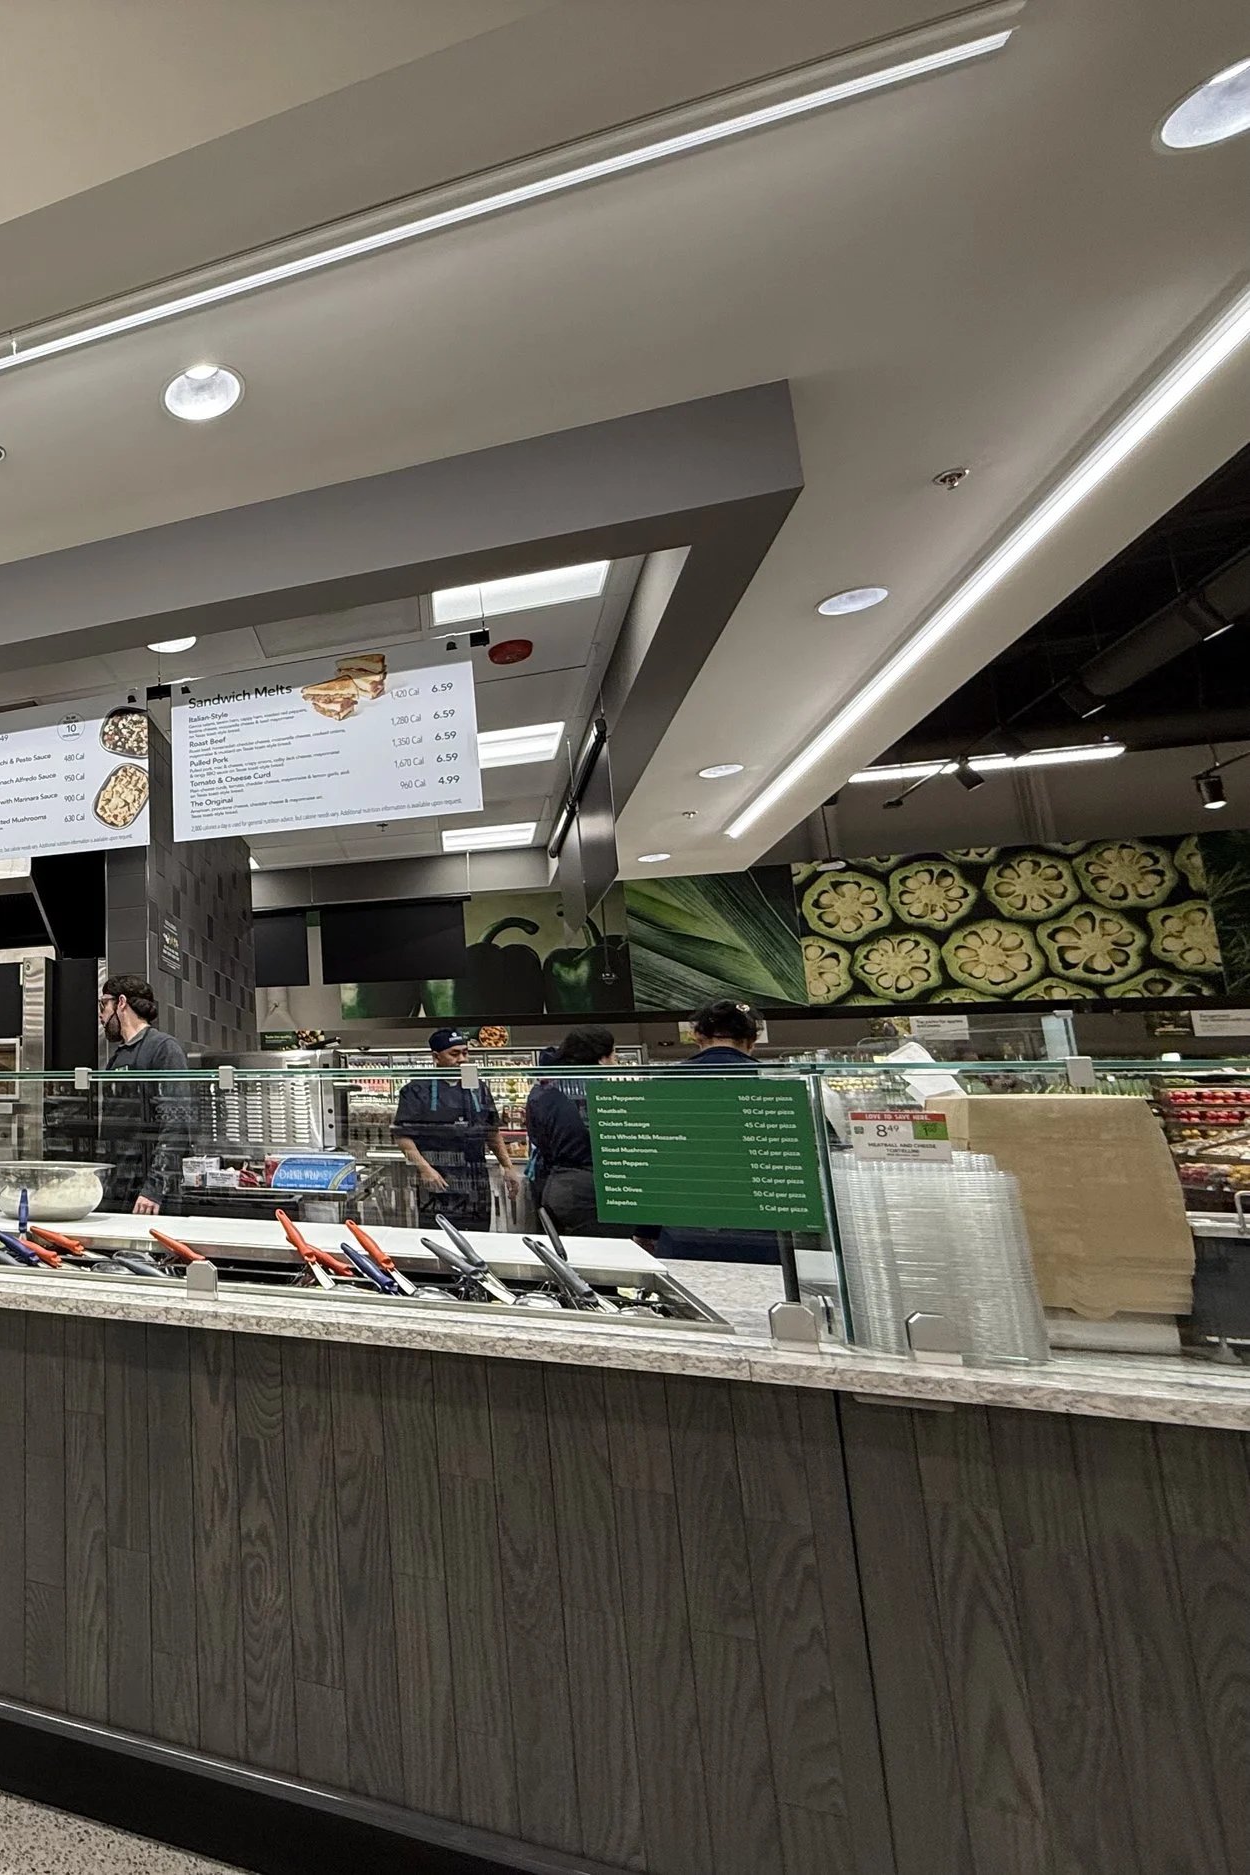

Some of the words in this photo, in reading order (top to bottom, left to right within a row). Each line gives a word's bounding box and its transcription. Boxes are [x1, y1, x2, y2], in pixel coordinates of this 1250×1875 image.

[409, 688, 420, 697] Cal
[431, 682, 454, 693] 6.59
[188, 691, 250, 709] Sandwich
[254, 684, 292, 699] Melts
[189, 712, 228, 723] Italian-Style
[410, 714, 422, 724] Cal
[433, 709, 456, 720] 6.59
[66, 724, 77, 733] 10
[412, 736, 423, 745] Cal
[435, 731, 457, 742] 6.59
[190, 740, 209, 748] Roast
[210, 737, 226, 745] Beef
[413, 757, 424, 767] Cal
[436, 753, 458, 763] 6.59
[190, 780, 216, 788] Tomato
[225, 775, 252, 783] Cheese
[253, 771, 271, 780] Curd
[414, 778, 426, 788] Cal
[438, 775, 460, 785] 4.99
[205, 798, 234, 806] Original
[12, 815, 47, 823] Mushrooms
